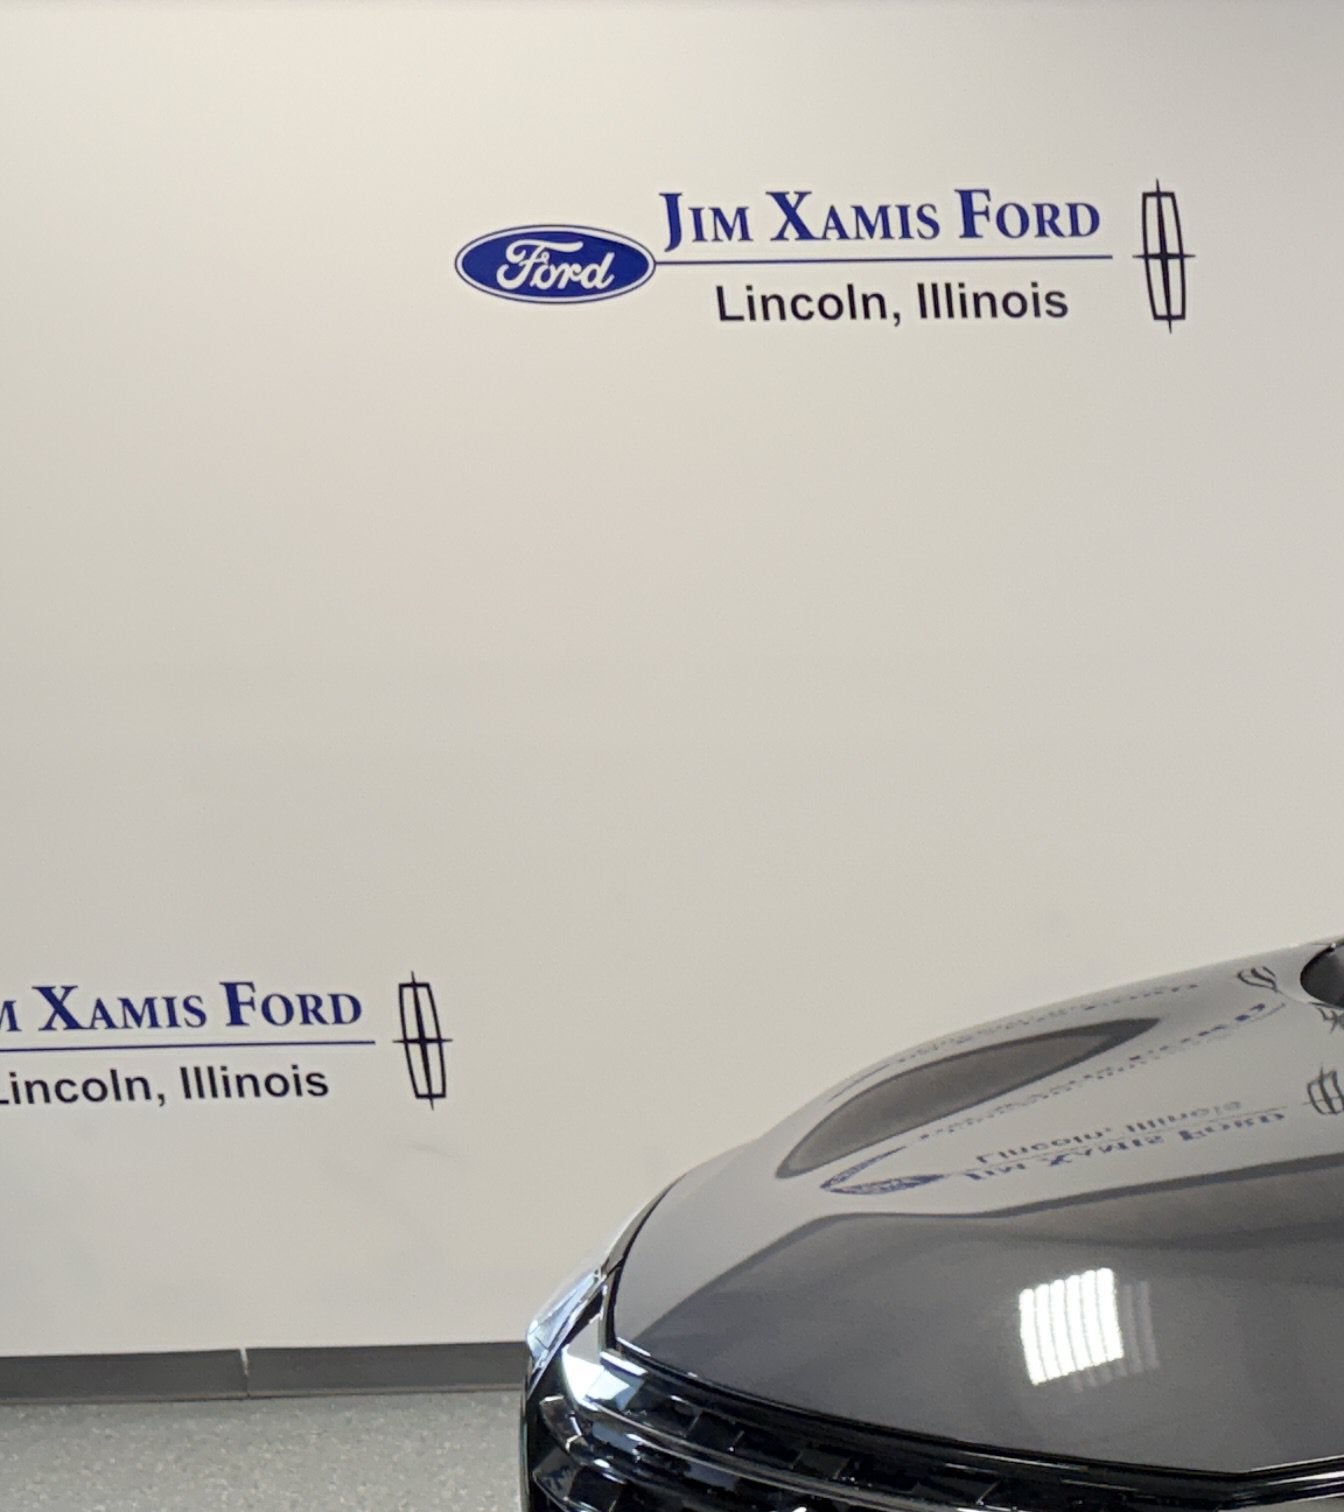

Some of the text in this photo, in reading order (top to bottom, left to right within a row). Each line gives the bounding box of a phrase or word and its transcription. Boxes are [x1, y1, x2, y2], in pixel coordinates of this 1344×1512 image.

[658, 188, 1101, 253] JIM XAMIS FORD
[496, 240, 615, 290] Ford
[715, 280, 1069, 327] Lincoln, Illinois
[31, 984, 208, 1032] XAMIS
[218, 980, 363, 1027] FORD
[179, 1063, 330, 1100] Illinois
